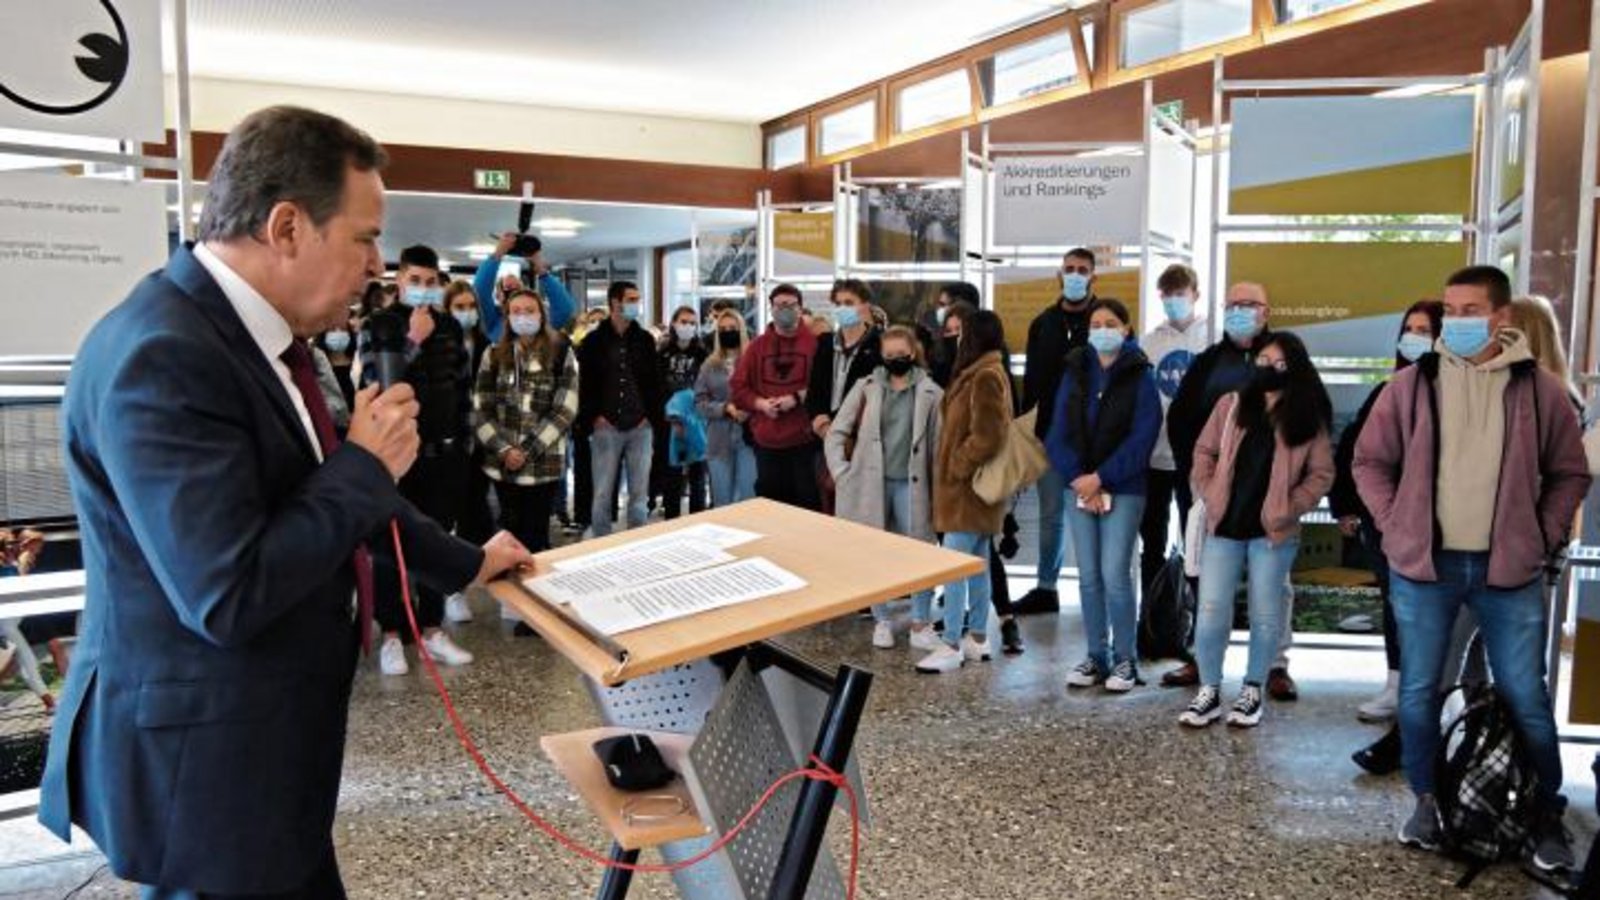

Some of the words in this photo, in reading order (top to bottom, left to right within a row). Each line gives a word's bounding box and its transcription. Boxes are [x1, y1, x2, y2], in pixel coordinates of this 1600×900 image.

[1003, 165, 1131, 181] Akkreditierungen
[1003, 183, 1031, 197] und
[1036, 182, 1107, 199] Rankings
